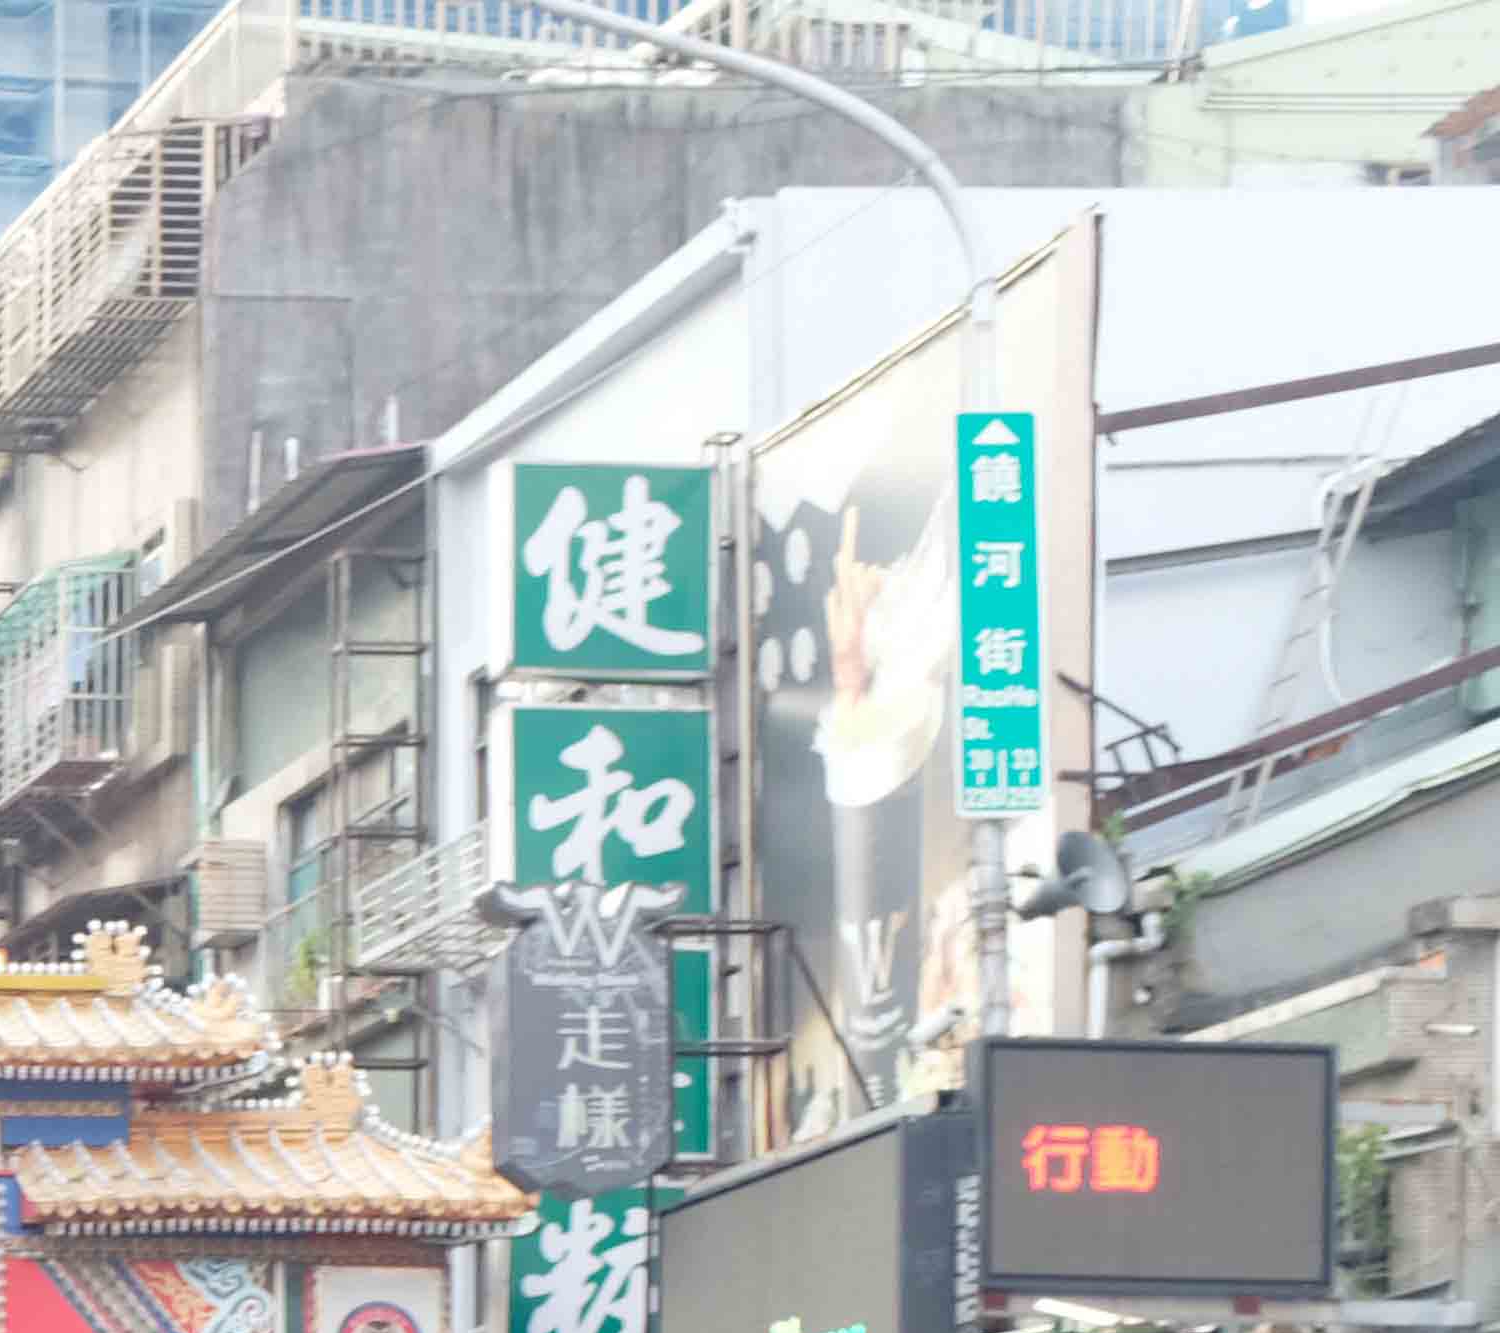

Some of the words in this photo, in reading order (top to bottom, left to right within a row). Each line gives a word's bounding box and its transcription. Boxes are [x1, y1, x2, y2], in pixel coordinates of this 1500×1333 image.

[970, 454, 1028, 676] 饒河街
[556, 1005, 632, 1149] 走樣
[1021, 1122, 1161, 1195] 行動
